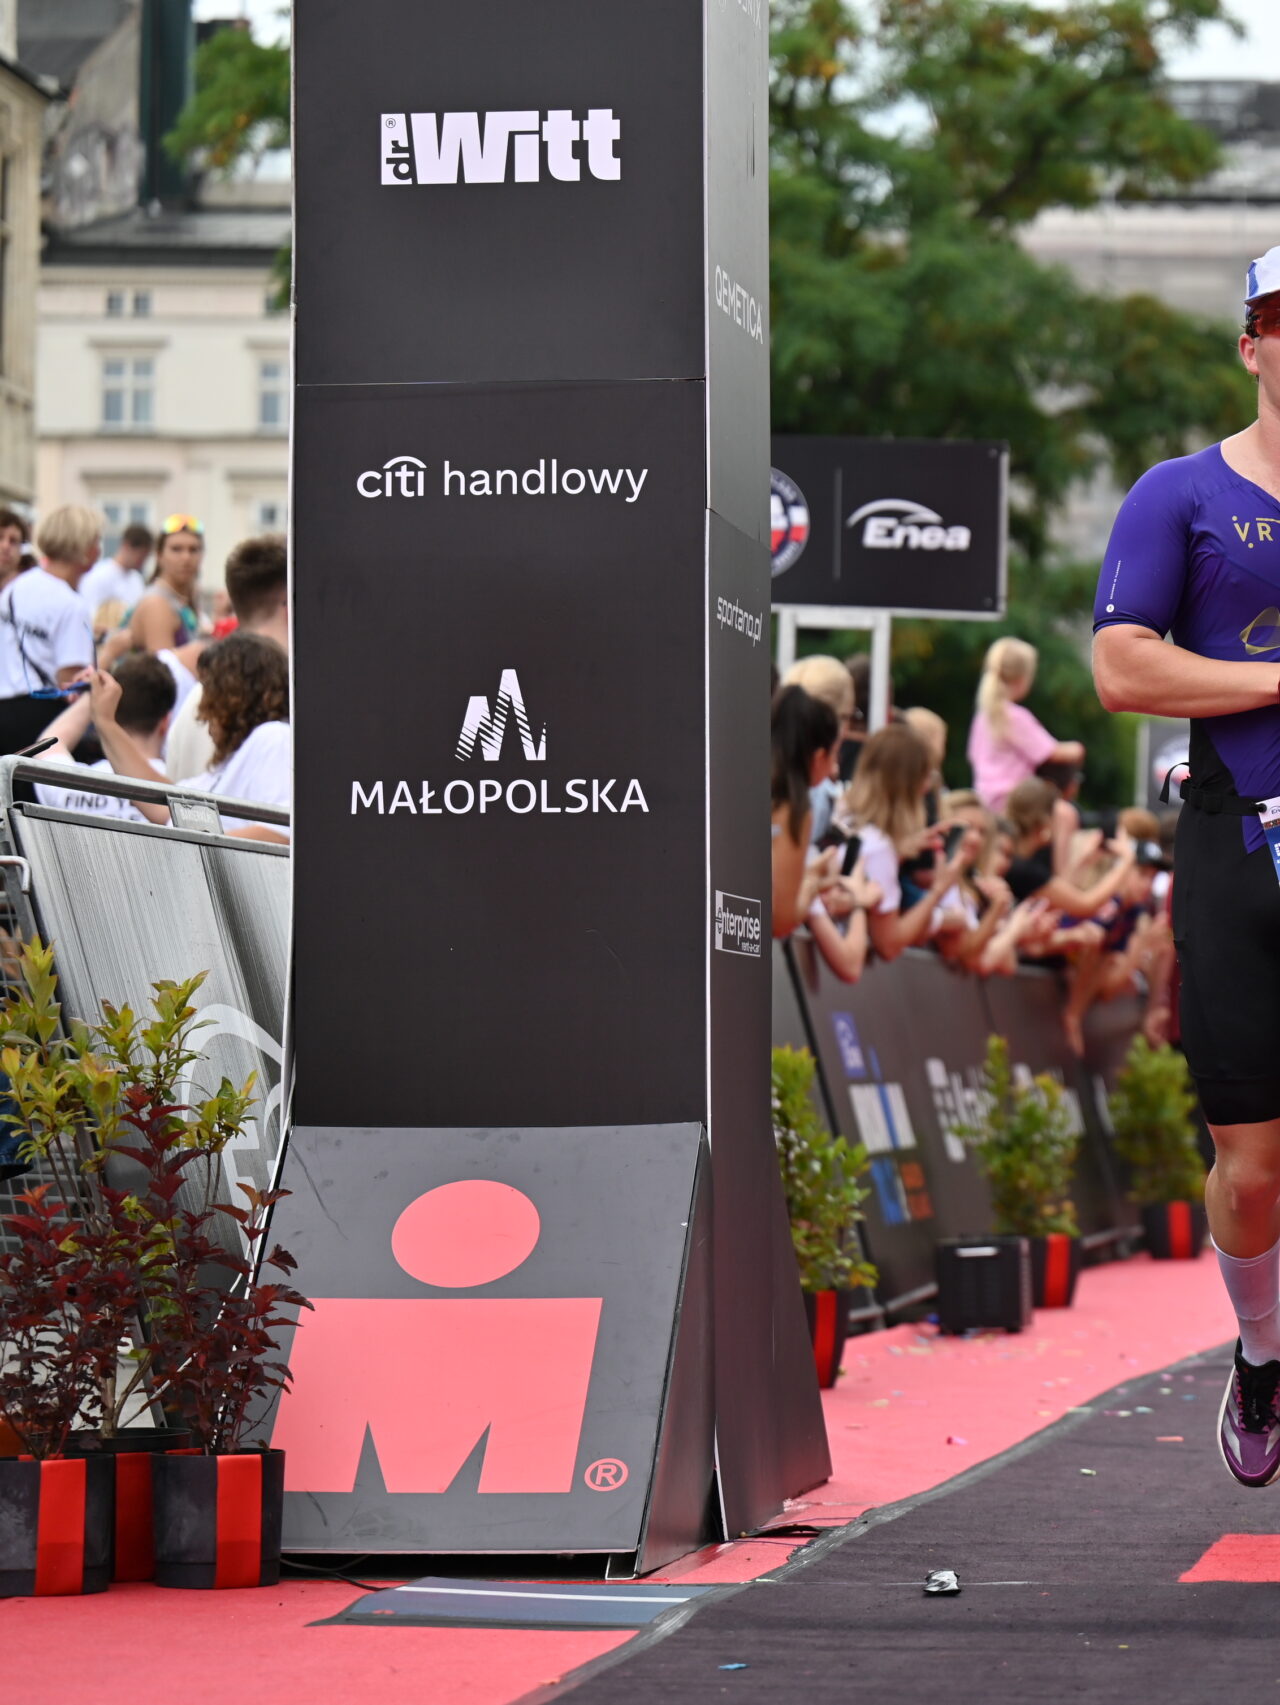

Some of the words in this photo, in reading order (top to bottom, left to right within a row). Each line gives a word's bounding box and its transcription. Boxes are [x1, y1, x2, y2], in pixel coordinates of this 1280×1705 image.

[410, 108, 621, 185] Witt
[715, 264, 763, 345] QEMETICA
[357, 456, 427, 498] citi
[444, 459, 649, 503] handlowy
[861, 515, 972, 550] Enea
[716, 596, 763, 648] sportano.pl
[64, 795, 108, 810] FIND
[350, 778, 650, 815] MAŁOPOLSKA
